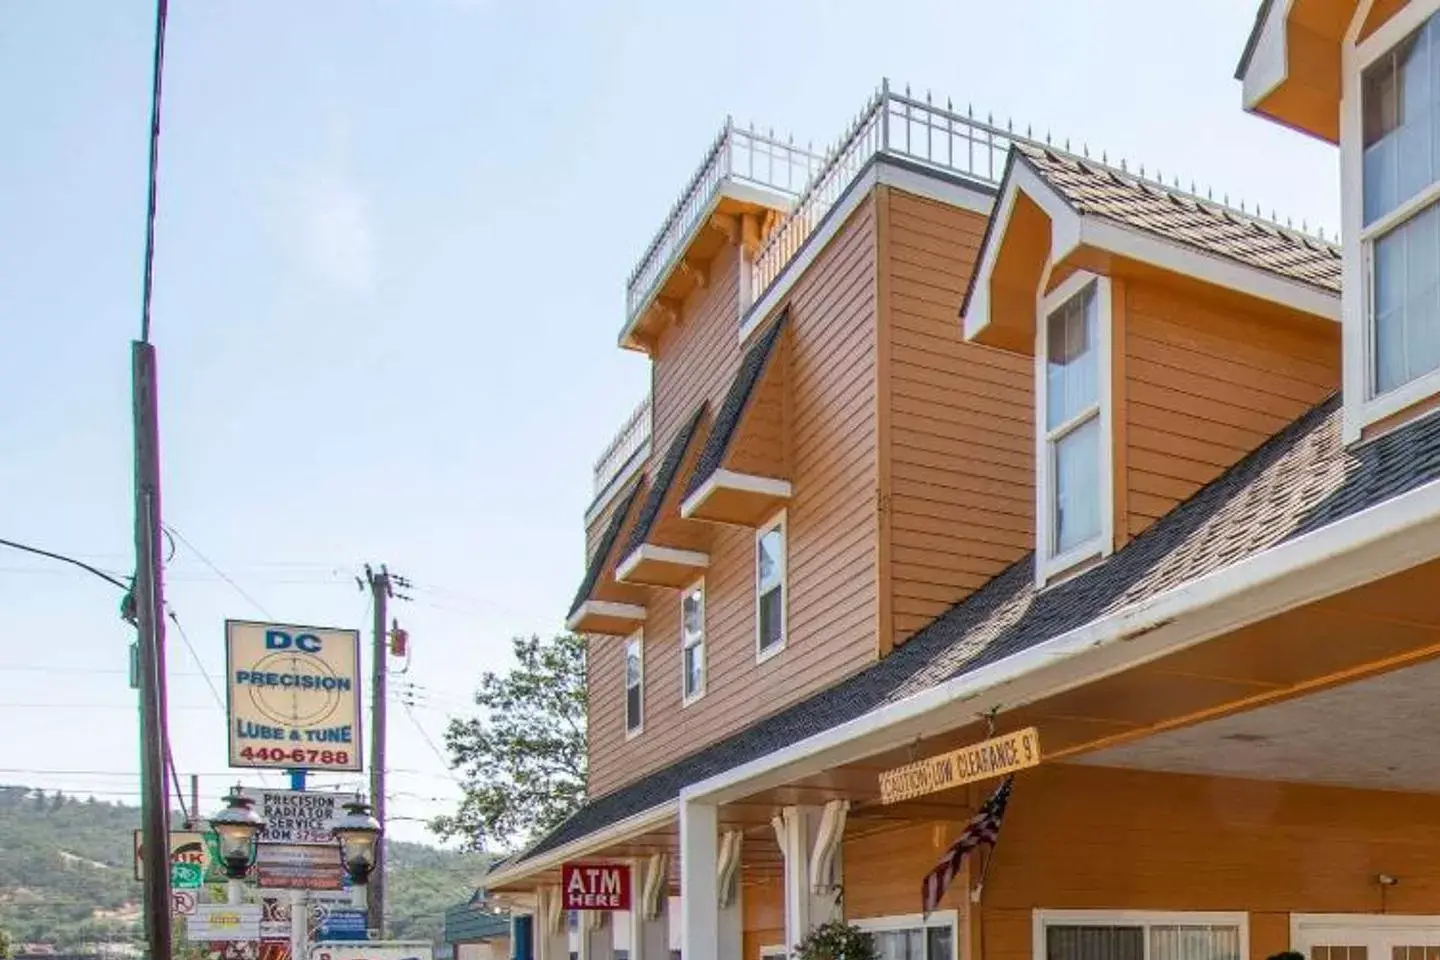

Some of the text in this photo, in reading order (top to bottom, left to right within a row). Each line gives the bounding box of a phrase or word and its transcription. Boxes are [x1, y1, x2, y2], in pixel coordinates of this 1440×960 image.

[265, 629, 322, 653] DC
[235, 670, 351, 692] PRECISION
[236, 718, 352, 744] LUBE & TUNE
[240, 746, 349, 765] 440-6788
[934, 757, 954, 787] LOW
[957, 738, 1020, 779] CLEARANCE
[264, 793, 335, 808] PRECISION
[264, 806, 333, 820] RADIATOR
[269, 818, 325, 830] SERVICE
[567, 868, 621, 894] ATM
[569, 893, 620, 907] HERE
